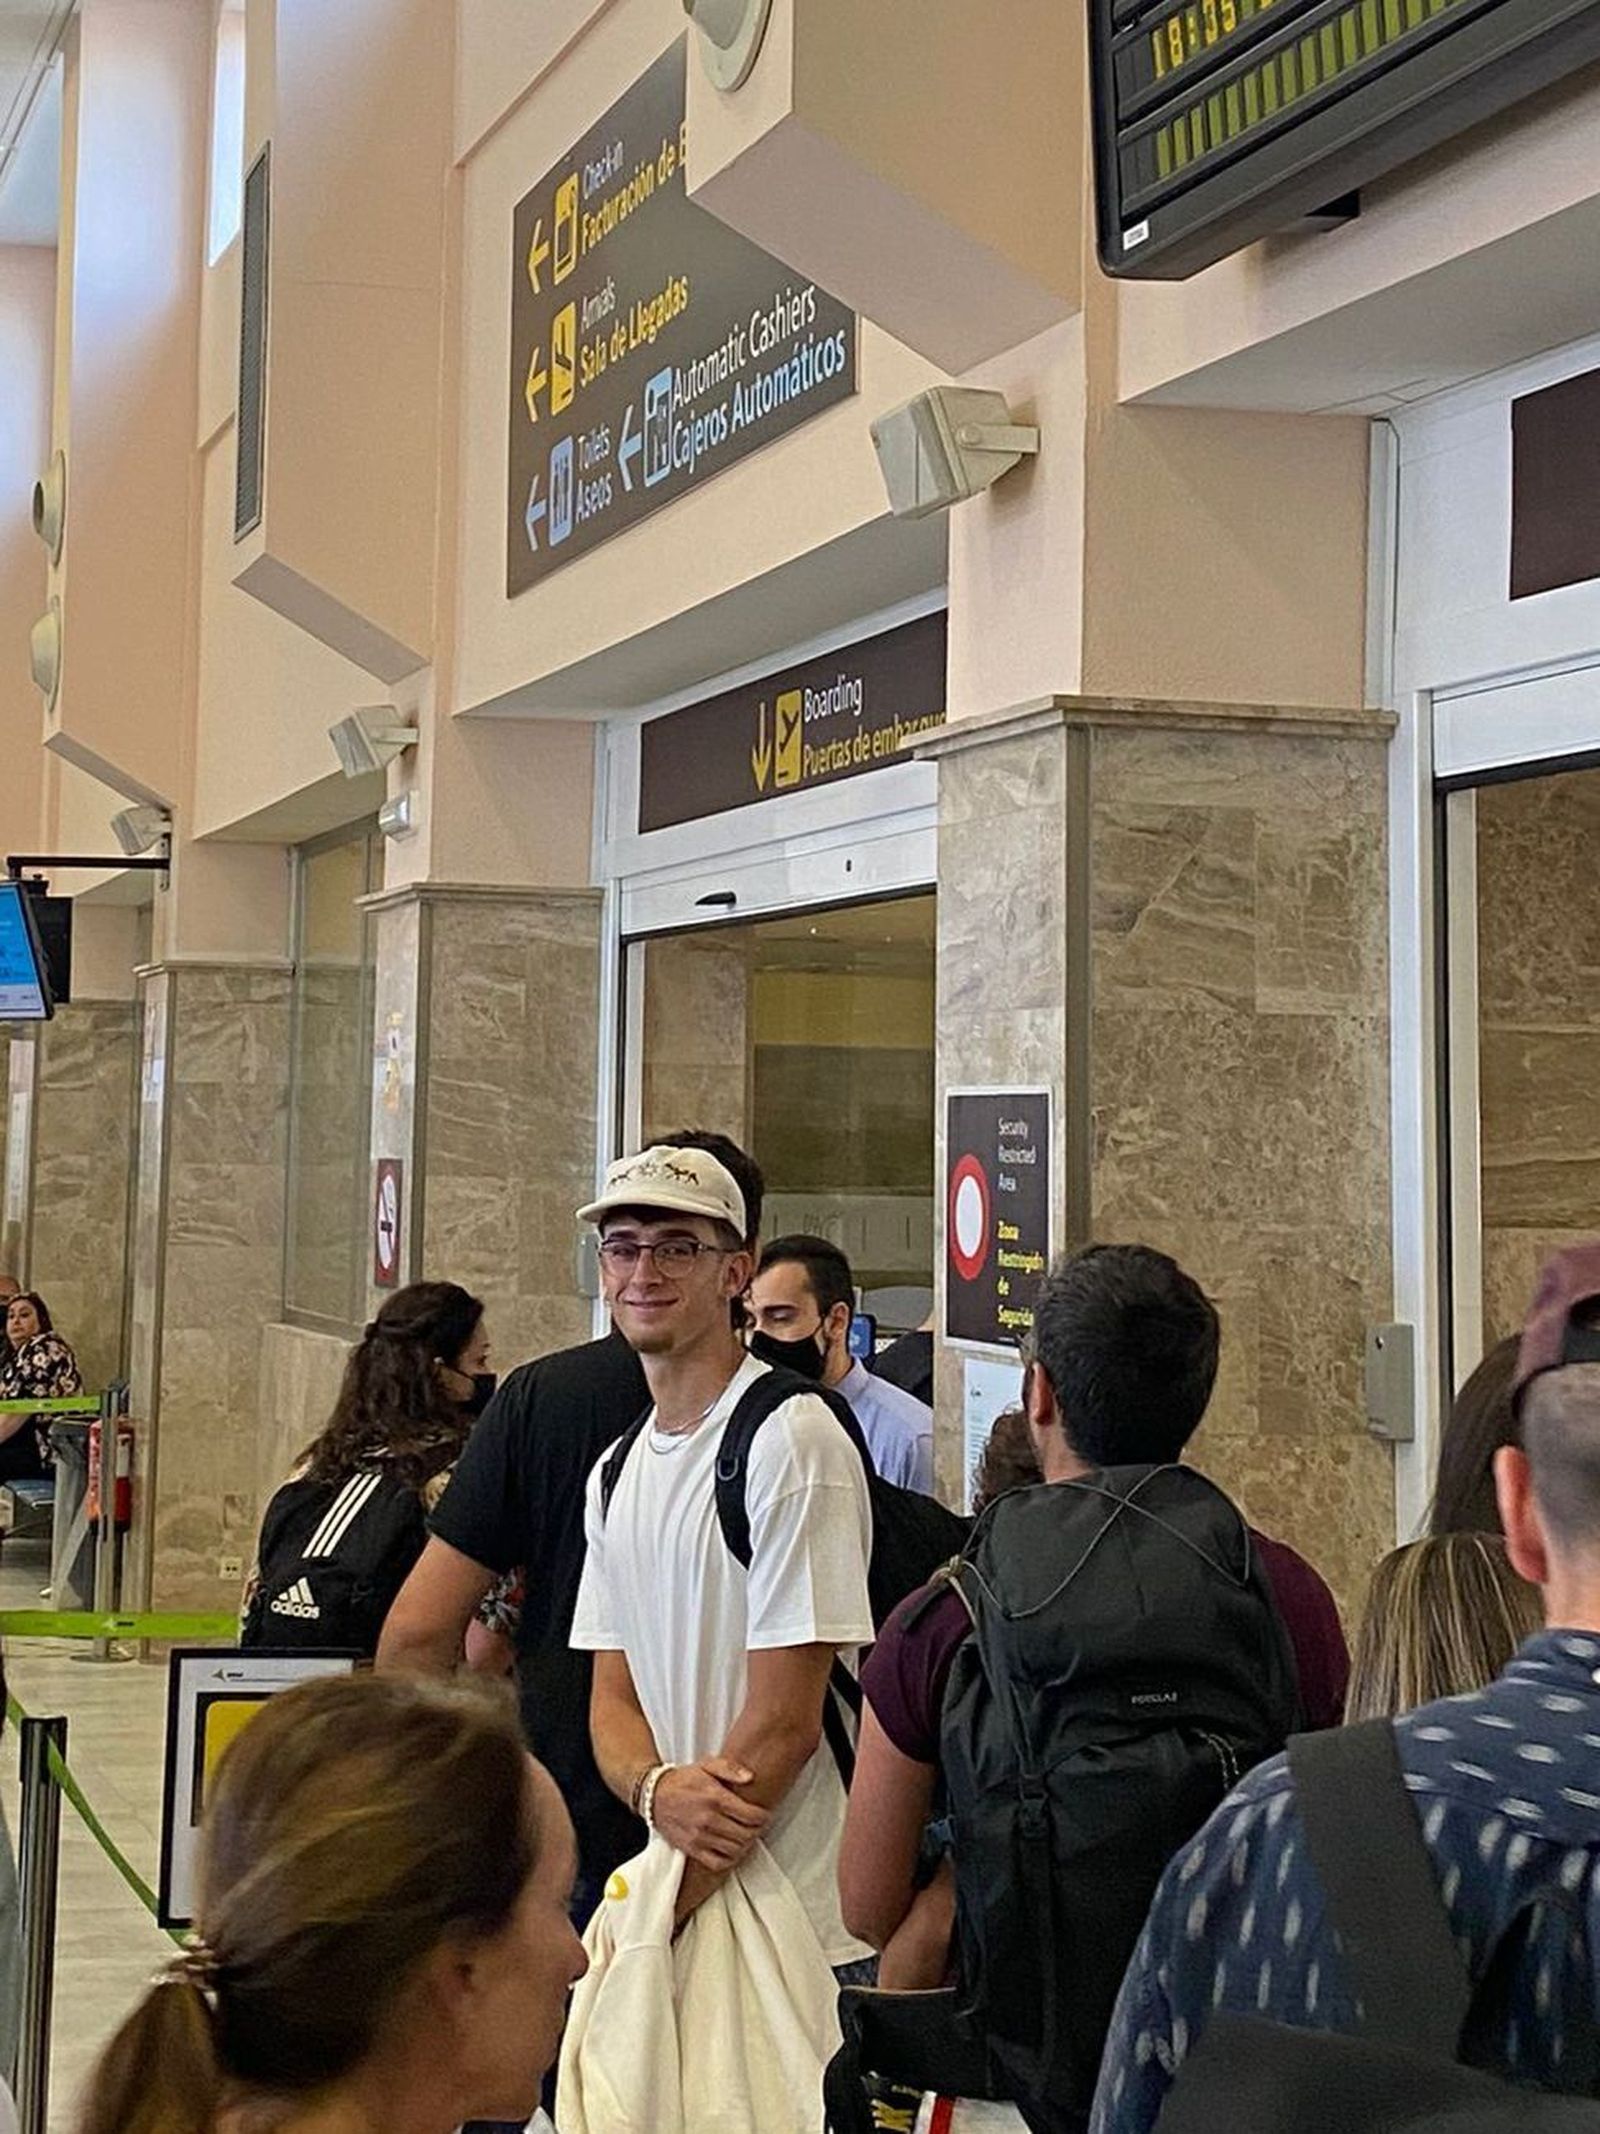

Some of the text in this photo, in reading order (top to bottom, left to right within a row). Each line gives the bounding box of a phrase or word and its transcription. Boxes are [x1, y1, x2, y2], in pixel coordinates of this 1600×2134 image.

[581, 161, 655, 255] Facturación
[657, 137, 677, 186] de
[583, 140, 624, 200] Check-in
[581, 275, 616, 333] Arrivals
[580, 275, 688, 388] Sala de Llegadas
[672, 284, 816, 412] Automatic Cashiers
[672, 329, 846, 475] Cajeros Automáticos
[577, 422, 611, 472] Toilets
[575, 472, 613, 524] Aseos
[804, 673, 864, 723] Boarding
[802, 737, 851, 778] Puertas
[852, 724, 871, 763] de
[998, 1117, 1029, 1141] Security
[997, 1276, 1009, 1295] de
[270, 1599, 321, 1619] adidas
